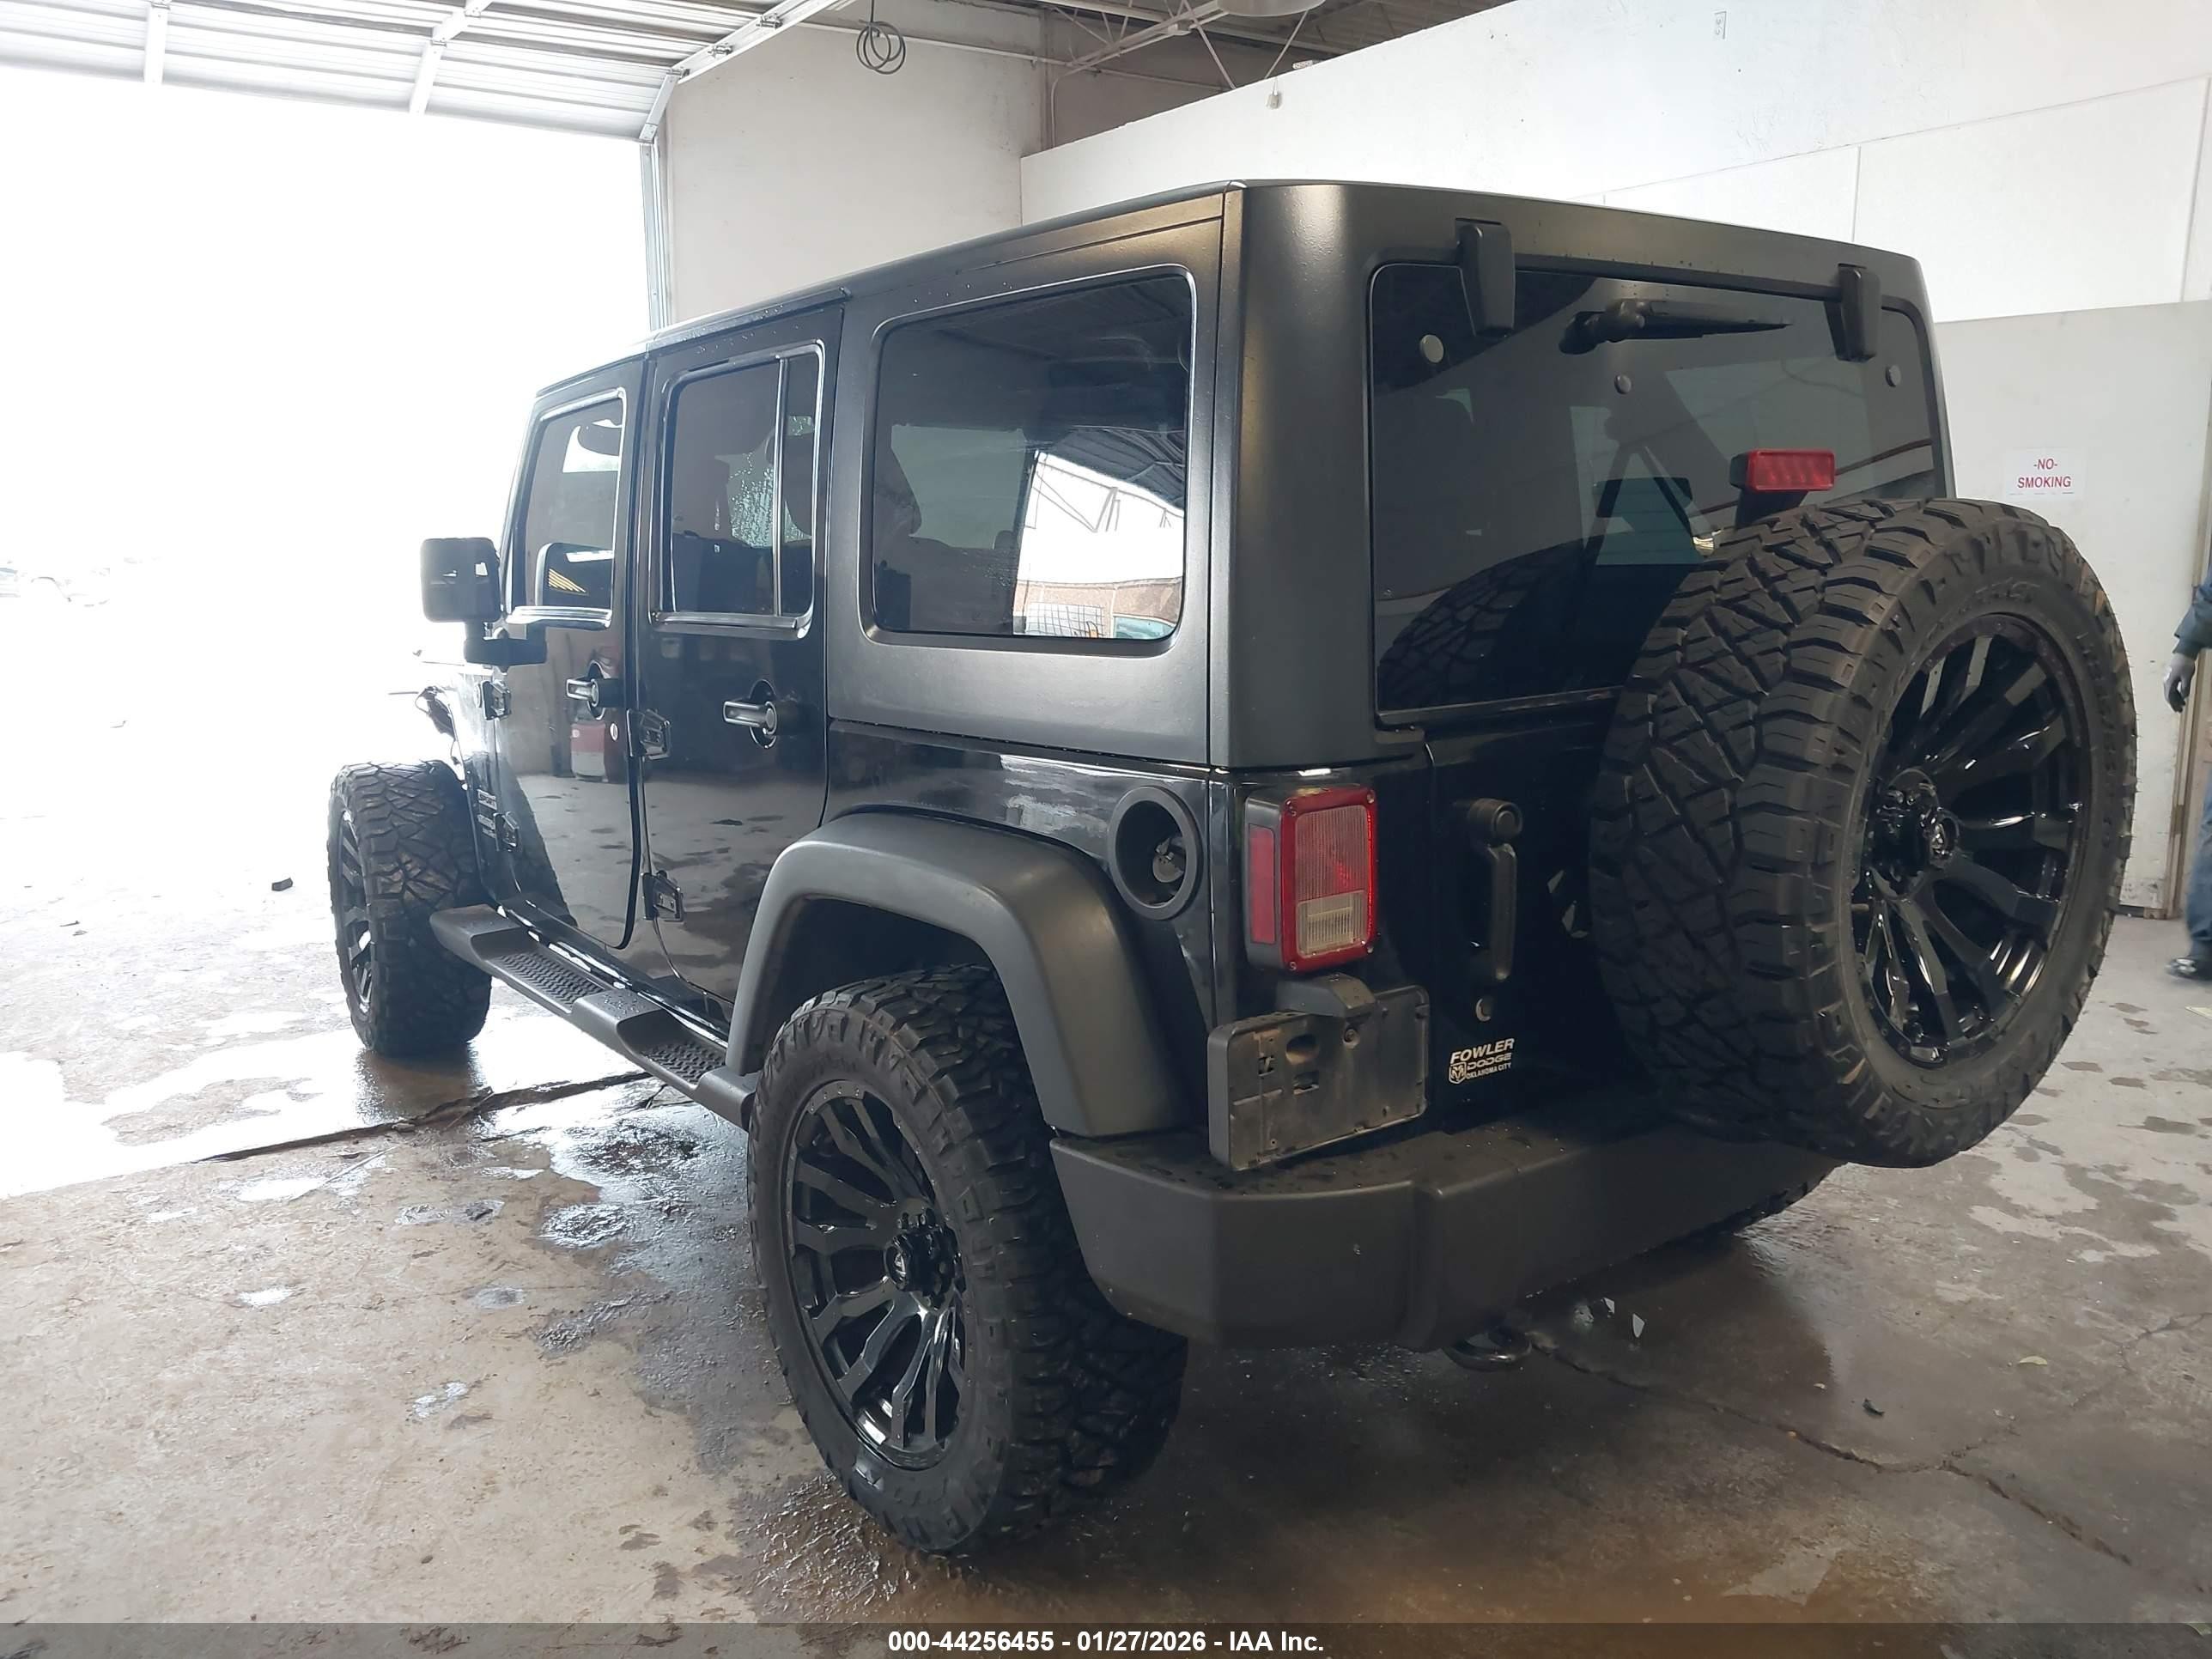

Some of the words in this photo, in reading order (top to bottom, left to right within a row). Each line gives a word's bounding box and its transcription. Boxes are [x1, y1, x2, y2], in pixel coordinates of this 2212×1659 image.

[2033, 458, 2058, 471] -NO-
[2017, 476, 2071, 489] SMOKING
[1449, 1037, 1515, 1064] FOWLER
[1467, 1053, 1512, 1070] DODGE
[1498, 1063, 1511, 1072] CITY
